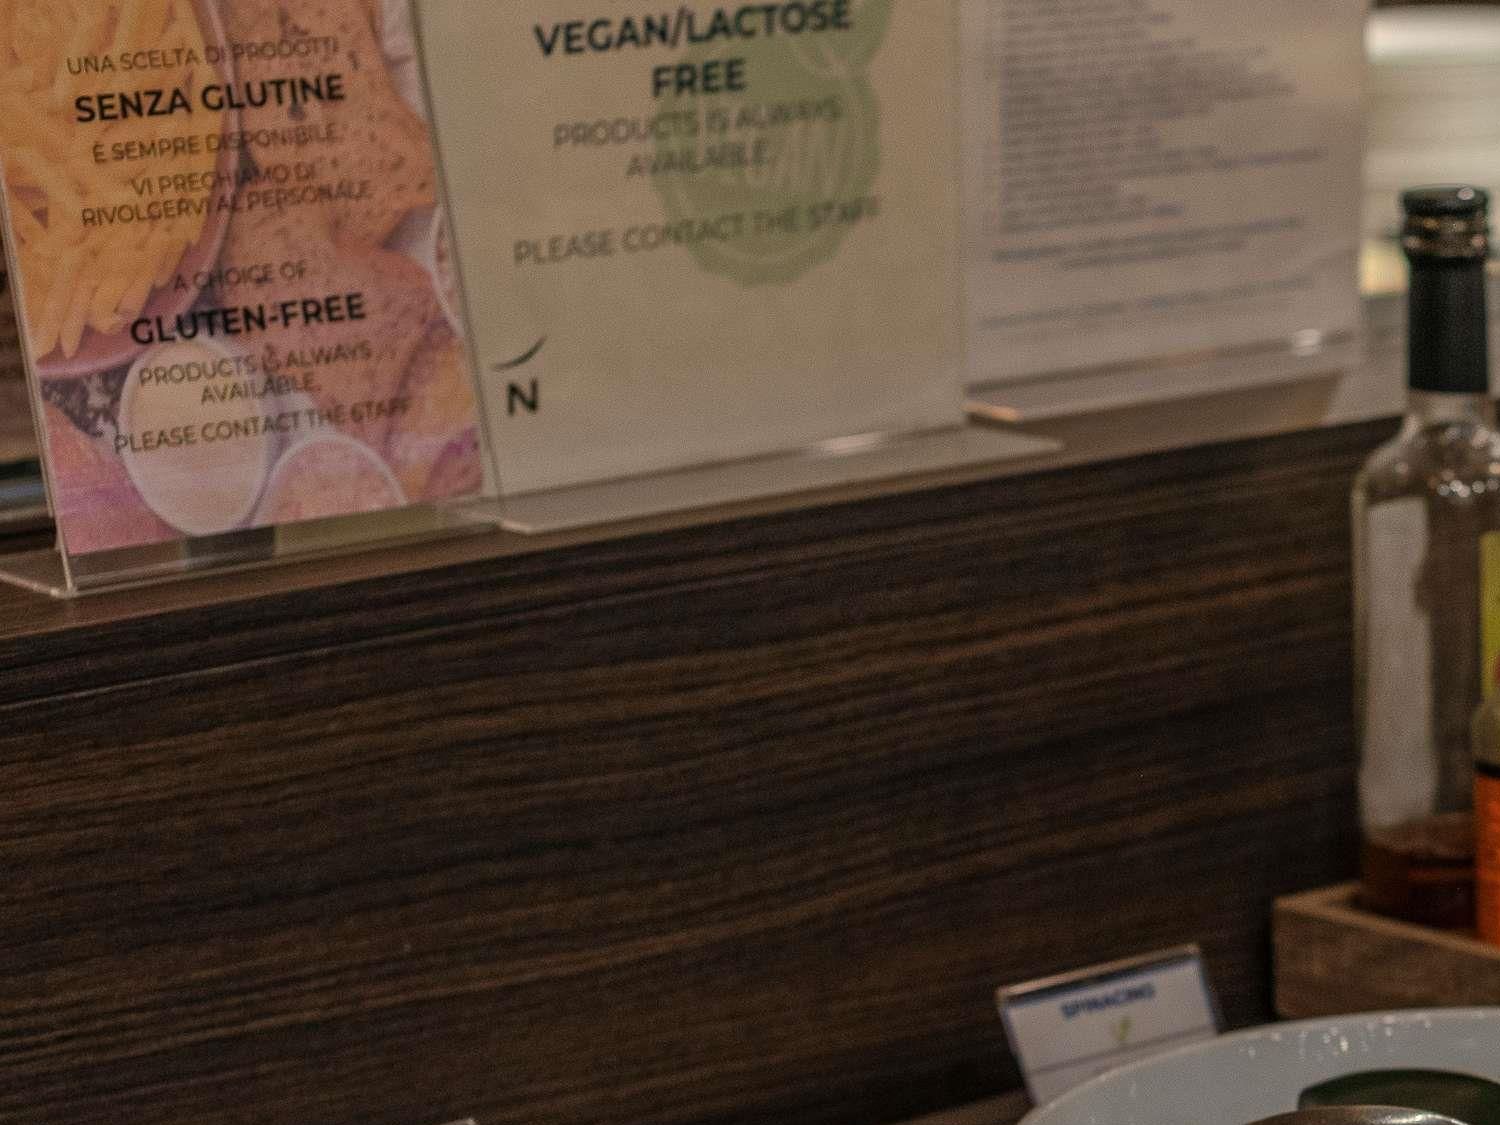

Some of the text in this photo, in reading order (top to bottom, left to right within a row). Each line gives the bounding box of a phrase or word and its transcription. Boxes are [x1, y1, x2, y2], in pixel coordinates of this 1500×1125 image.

[534, 0, 855, 57] VEGAN/LACTOSE
[66, 36, 339, 76] UNA SCELTA DI PRODOTTI
[75, 73, 346, 123] SENZA GLUTINE
[652, 58, 749, 98] FREE
[111, 134, 200, 162] SEMPRE
[553, 111, 699, 149] PRODUCTS
[81, 200, 209, 228] RIVOLGERVI
[247, 180, 373, 212] PERSONALE
[130, 177, 154, 197] VI
[514, 228, 613, 266] PLEASE
[622, 213, 745, 251] CONTACT
[173, 261, 307, 291] A CHOICE OF
[130, 292, 367, 345] GLUTEN-FREE
[139, 354, 257, 387] PRODUCTS
[286, 341, 372, 367] ALWAYS
[506, 378, 540, 416] N
[113, 424, 198, 455] PLEASE
[201, 411, 301, 443] CONTACT
[304, 404, 346, 428] THE
